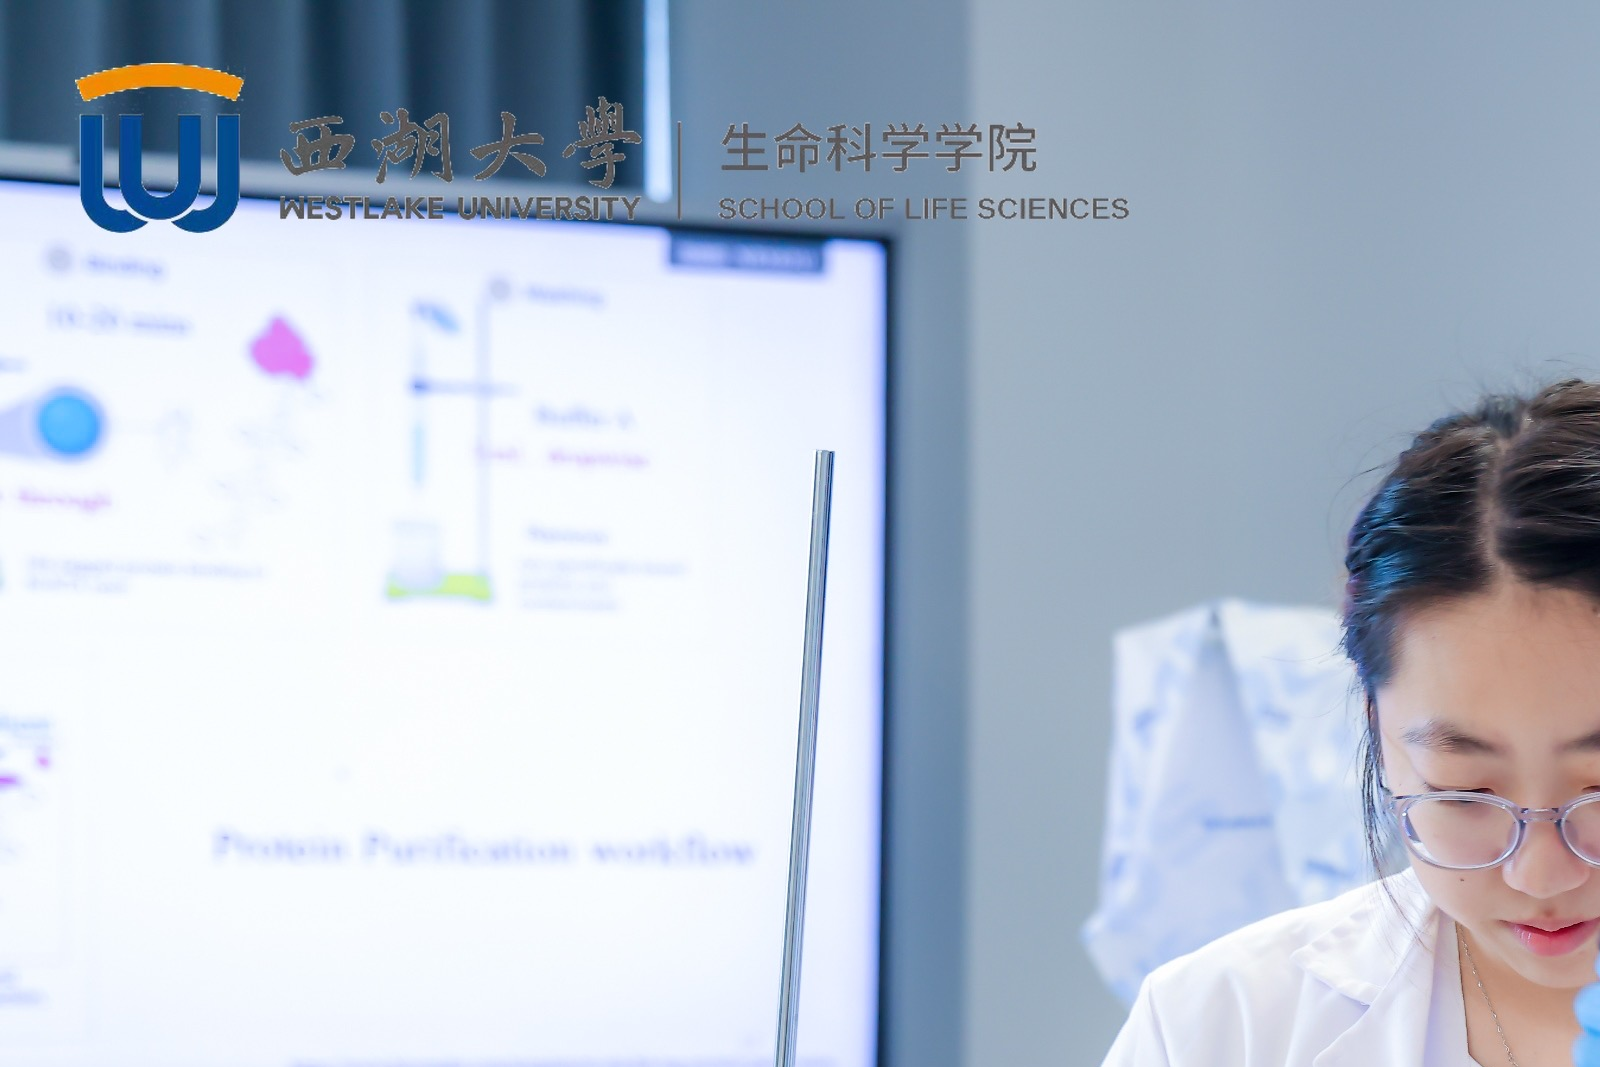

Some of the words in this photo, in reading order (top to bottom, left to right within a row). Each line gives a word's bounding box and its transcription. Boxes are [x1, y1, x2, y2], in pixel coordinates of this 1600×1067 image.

[212, 824, 344, 864] Protein
[360, 825, 572, 867] Purification
[591, 827, 756, 868] workflow
